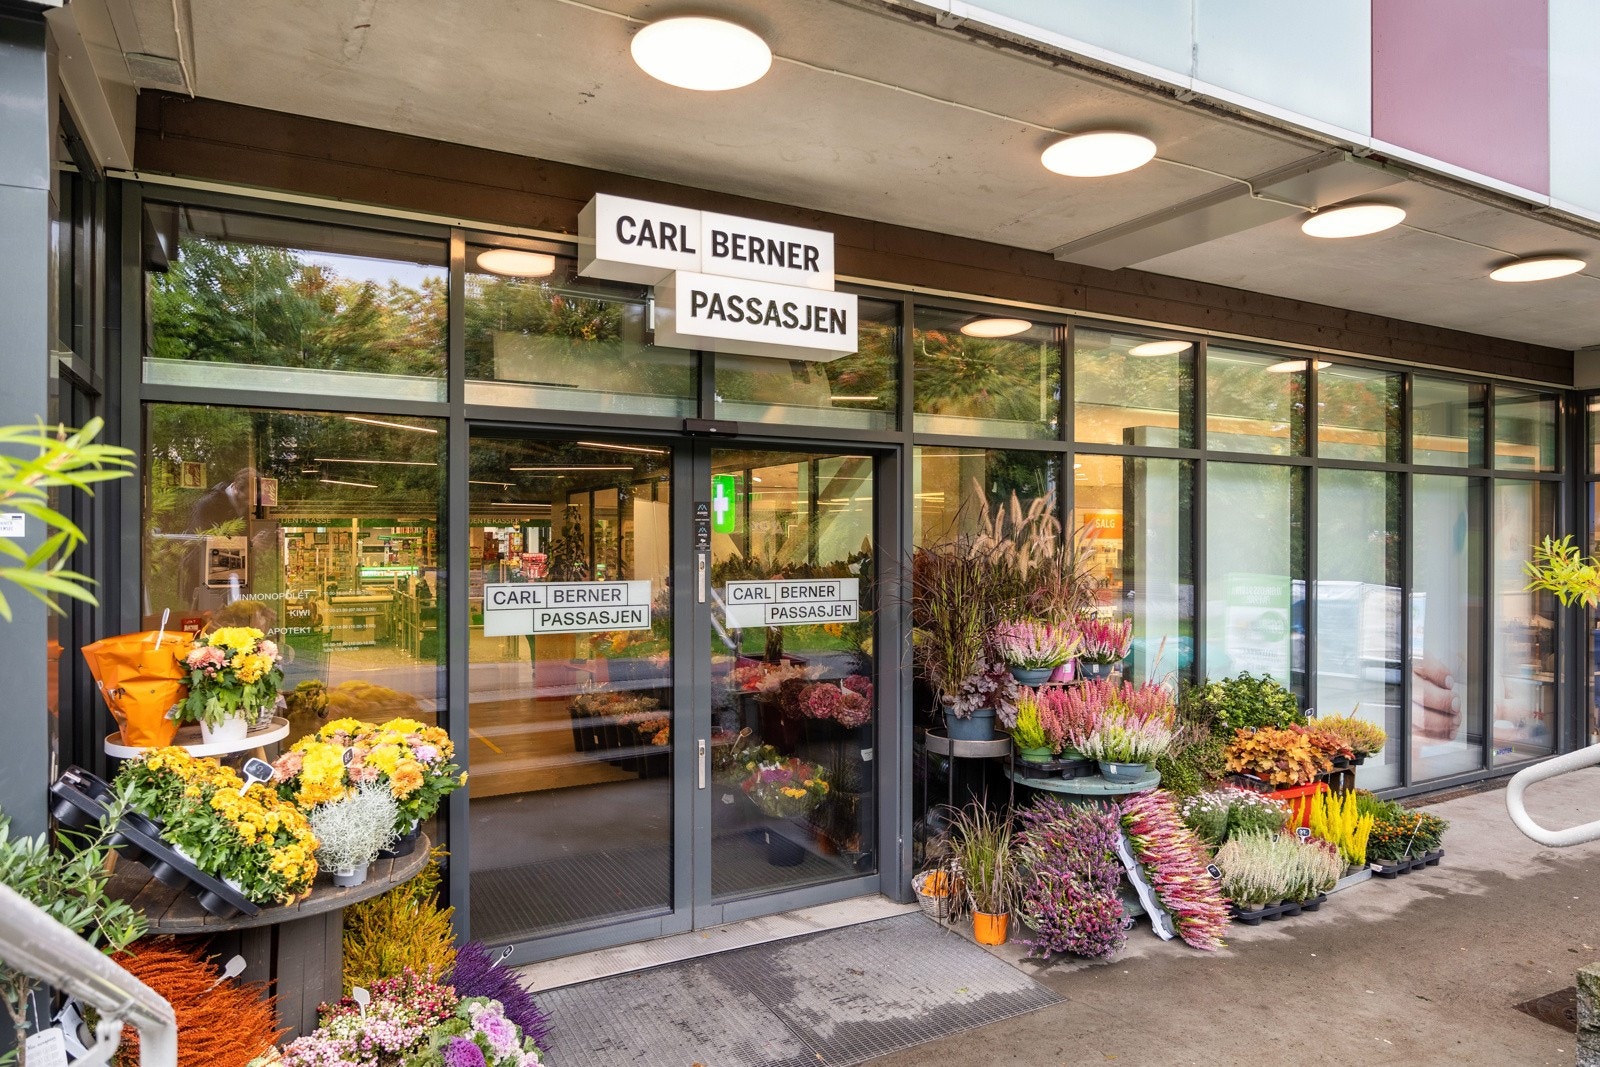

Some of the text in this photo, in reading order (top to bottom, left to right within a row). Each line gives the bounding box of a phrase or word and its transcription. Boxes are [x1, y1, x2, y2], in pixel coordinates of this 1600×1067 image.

[616, 215, 820, 273] CARL BERNER
[690, 289, 847, 335] PASSASJEN
[1095, 518, 1115, 529] SALG
[493, 588, 621, 605] CARL BERNER
[733, 585, 835, 600] CARL BERNER
[289, 609, 311, 617] KIWI
[541, 609, 642, 626] PASSASJEN
[771, 604, 851, 619] PASSASJEN
